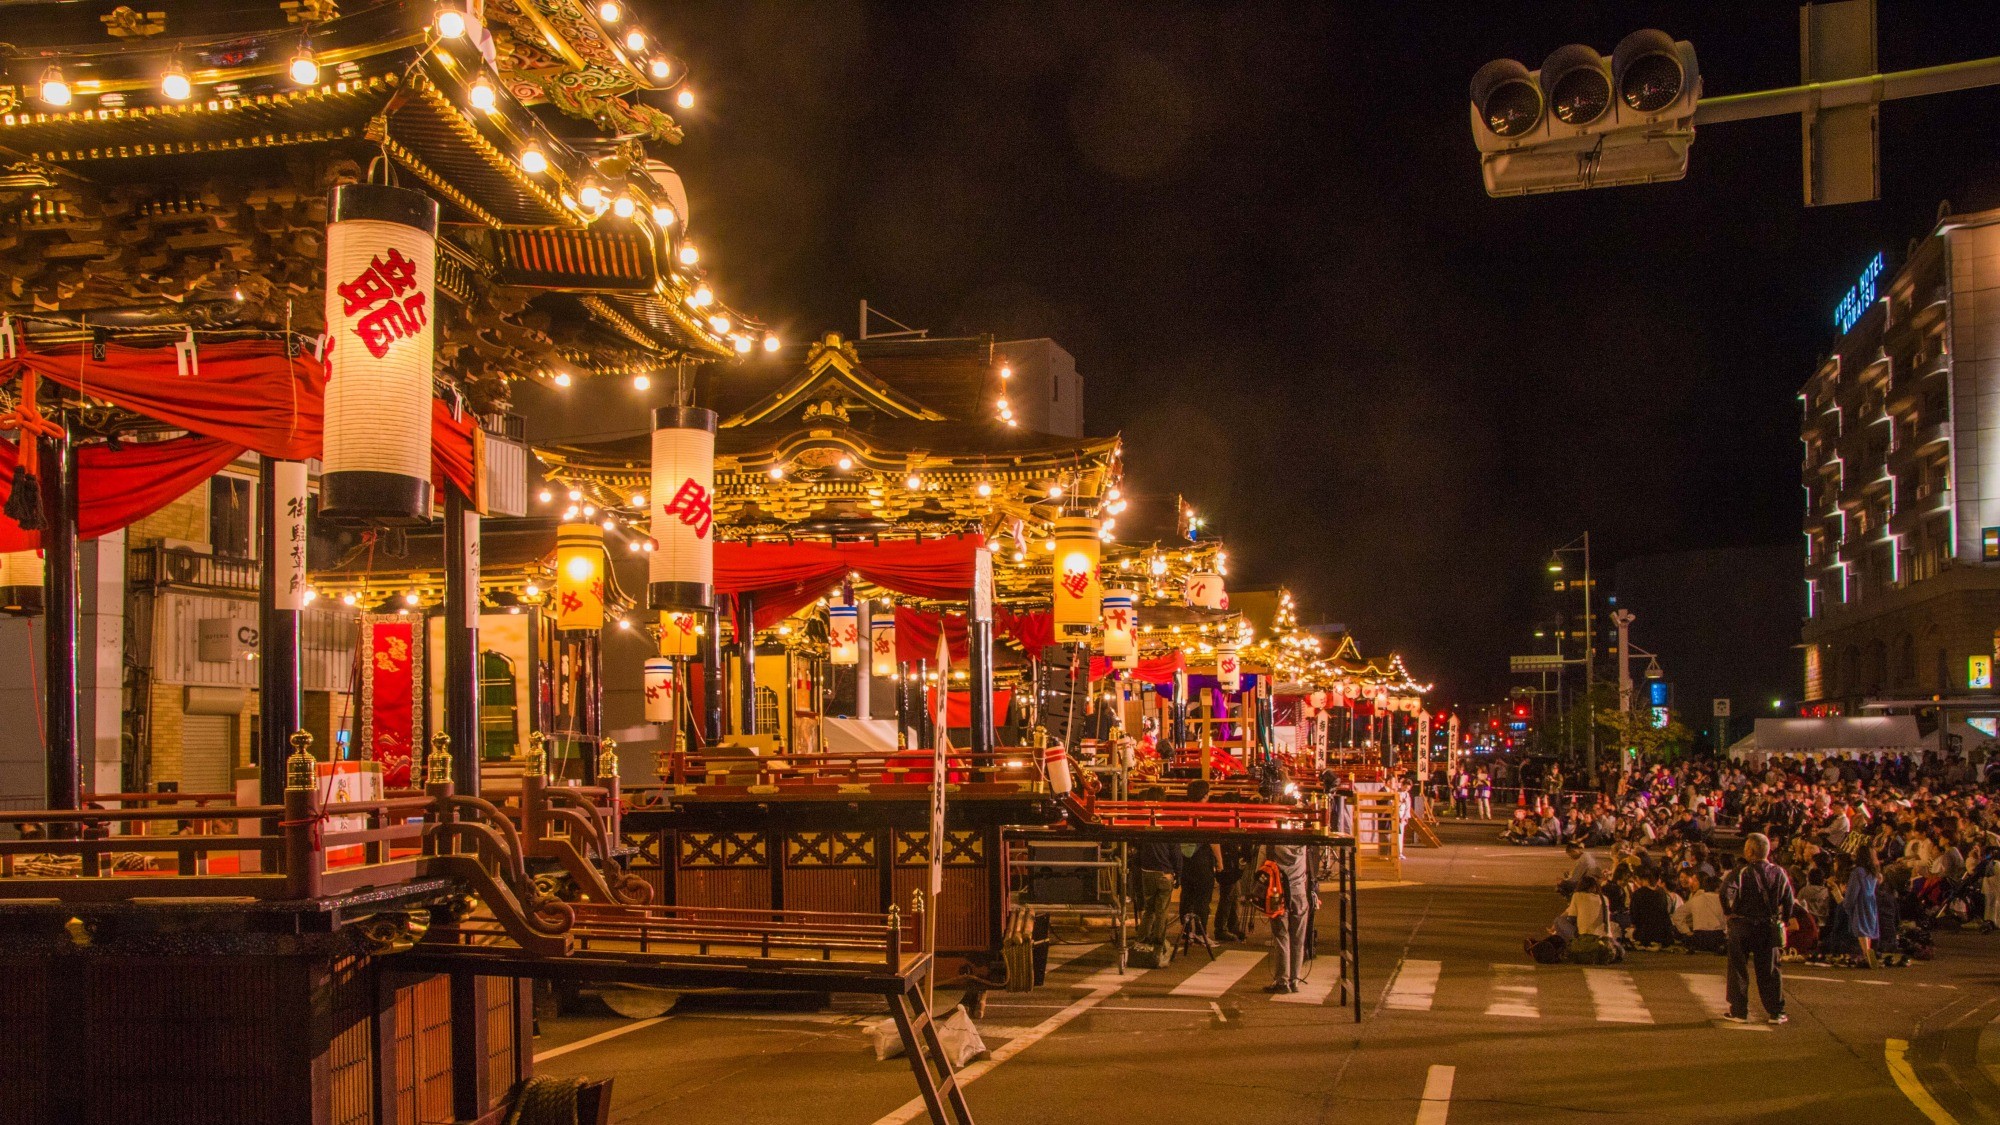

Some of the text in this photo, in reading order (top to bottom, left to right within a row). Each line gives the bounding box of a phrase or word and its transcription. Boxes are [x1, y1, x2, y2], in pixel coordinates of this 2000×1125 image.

[1860, 251, 1883, 294] HOTEL
[1842, 281, 1875, 335] KOMATSU
[663, 477, 712, 539] 助
